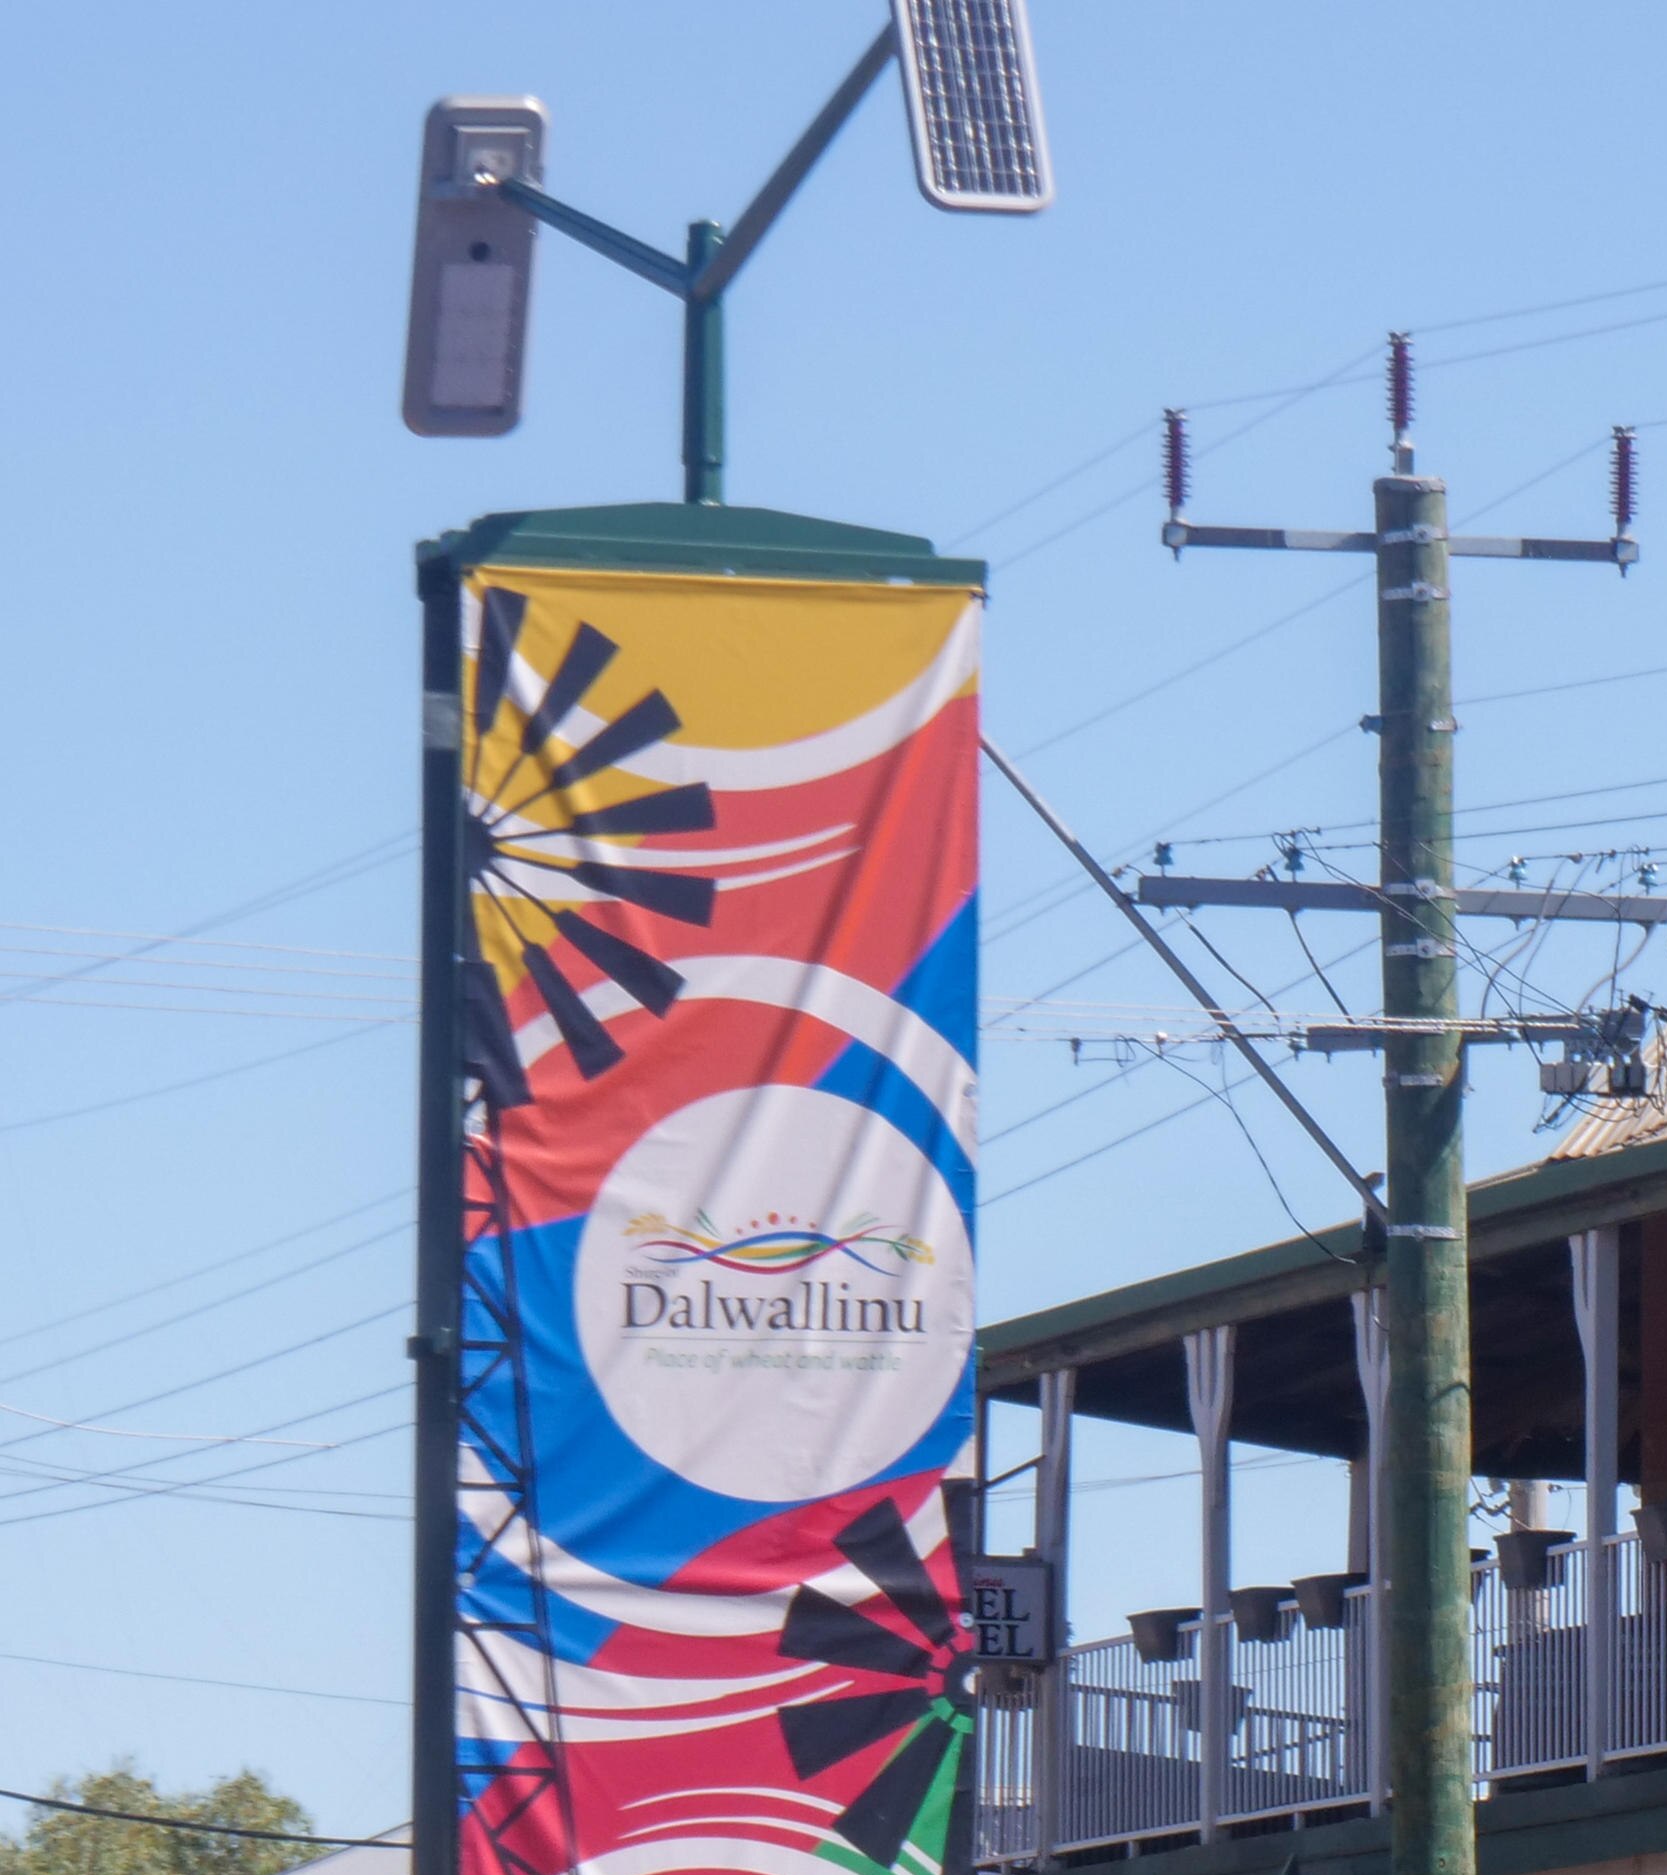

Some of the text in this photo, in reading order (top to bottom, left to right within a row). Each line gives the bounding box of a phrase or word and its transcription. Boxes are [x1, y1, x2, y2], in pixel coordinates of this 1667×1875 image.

[621, 1281, 926, 1333] Dalwallinu
[974, 1587, 1031, 1622] EL
[976, 1623, 1034, 1657] EL
